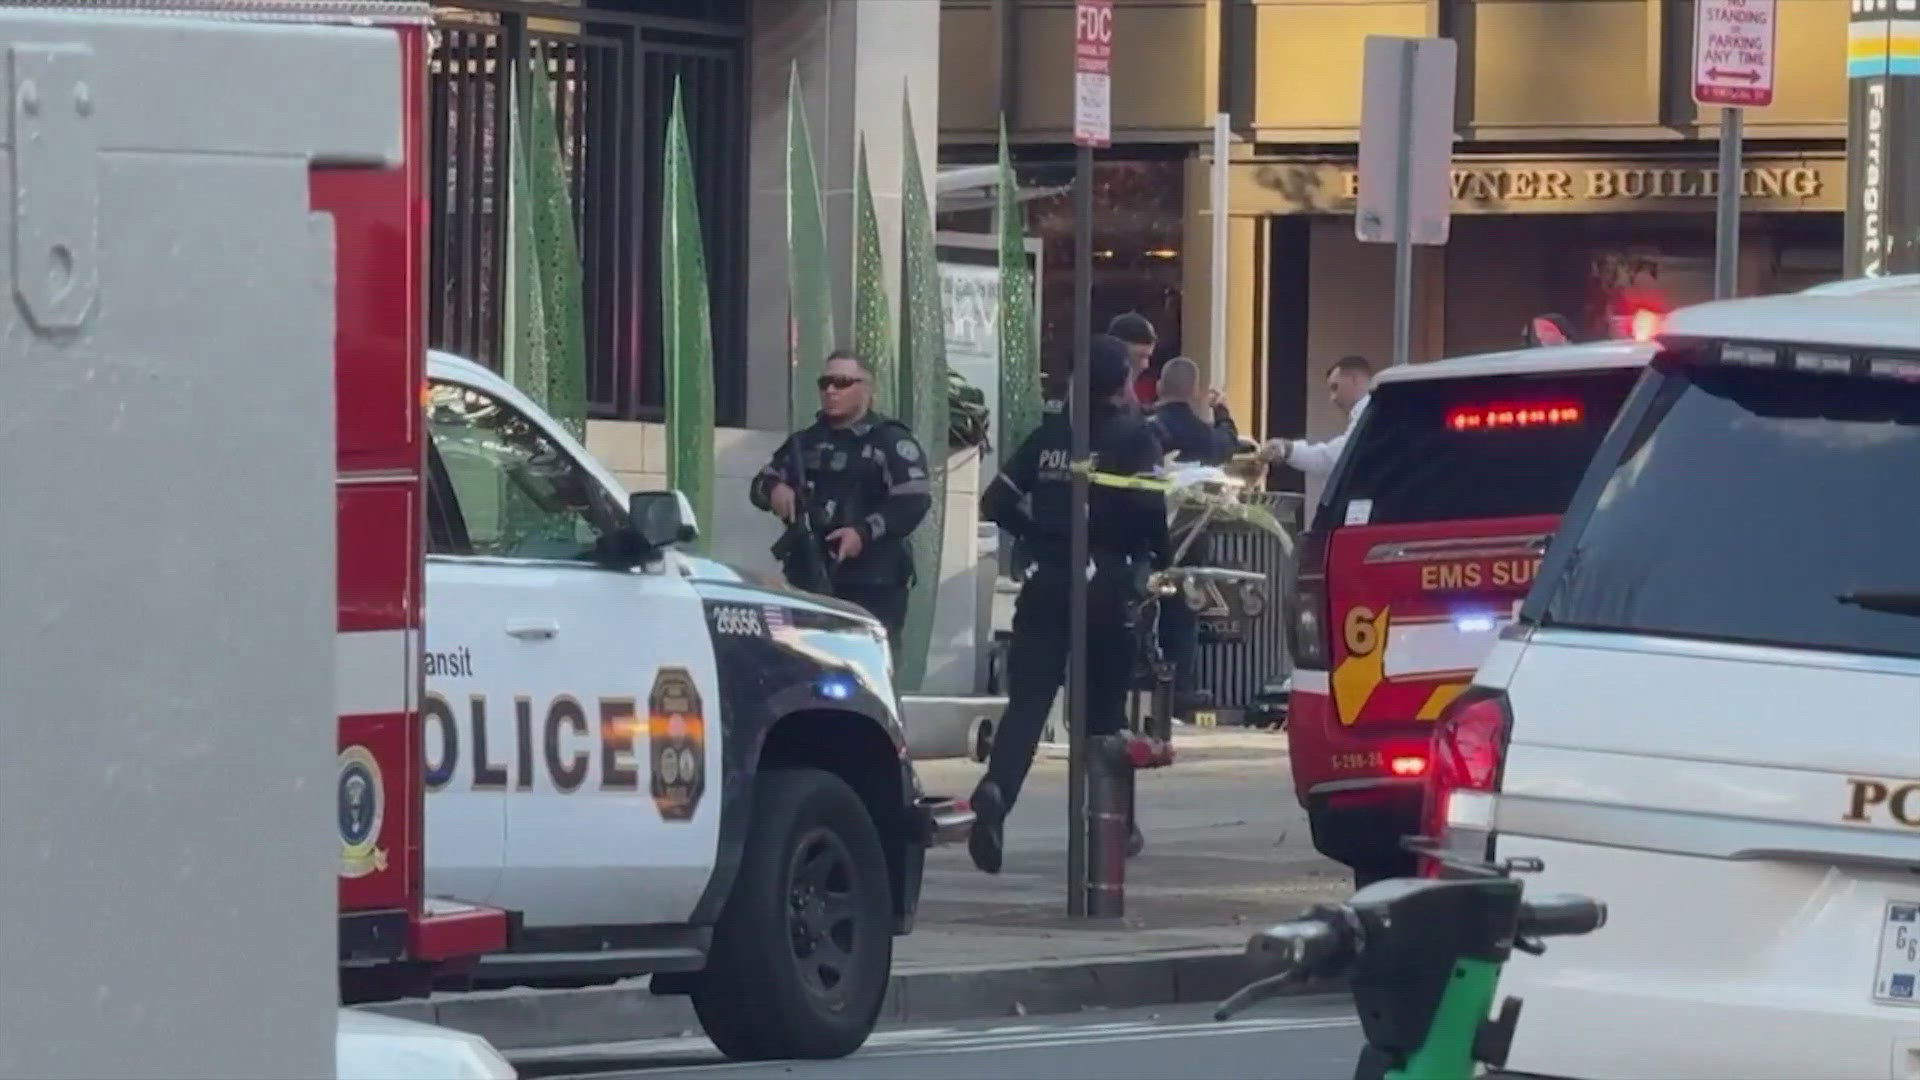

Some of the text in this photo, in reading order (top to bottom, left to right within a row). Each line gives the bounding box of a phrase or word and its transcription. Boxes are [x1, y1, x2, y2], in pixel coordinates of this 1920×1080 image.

[1077, 5, 1112, 43] FDC
[1706, 8, 1767, 24] STANDING
[1705, 50, 1766, 66] ANY TIME
[1709, 34, 1762, 49] PARKING
[1864, 84, 1884, 252] Farragut
[1421, 563, 1482, 590] EMS
[1345, 606, 1378, 658] 6
[424, 645, 473, 677] ansit
[424, 694, 639, 794] OLICE
[1842, 778, 1920, 828] PO
